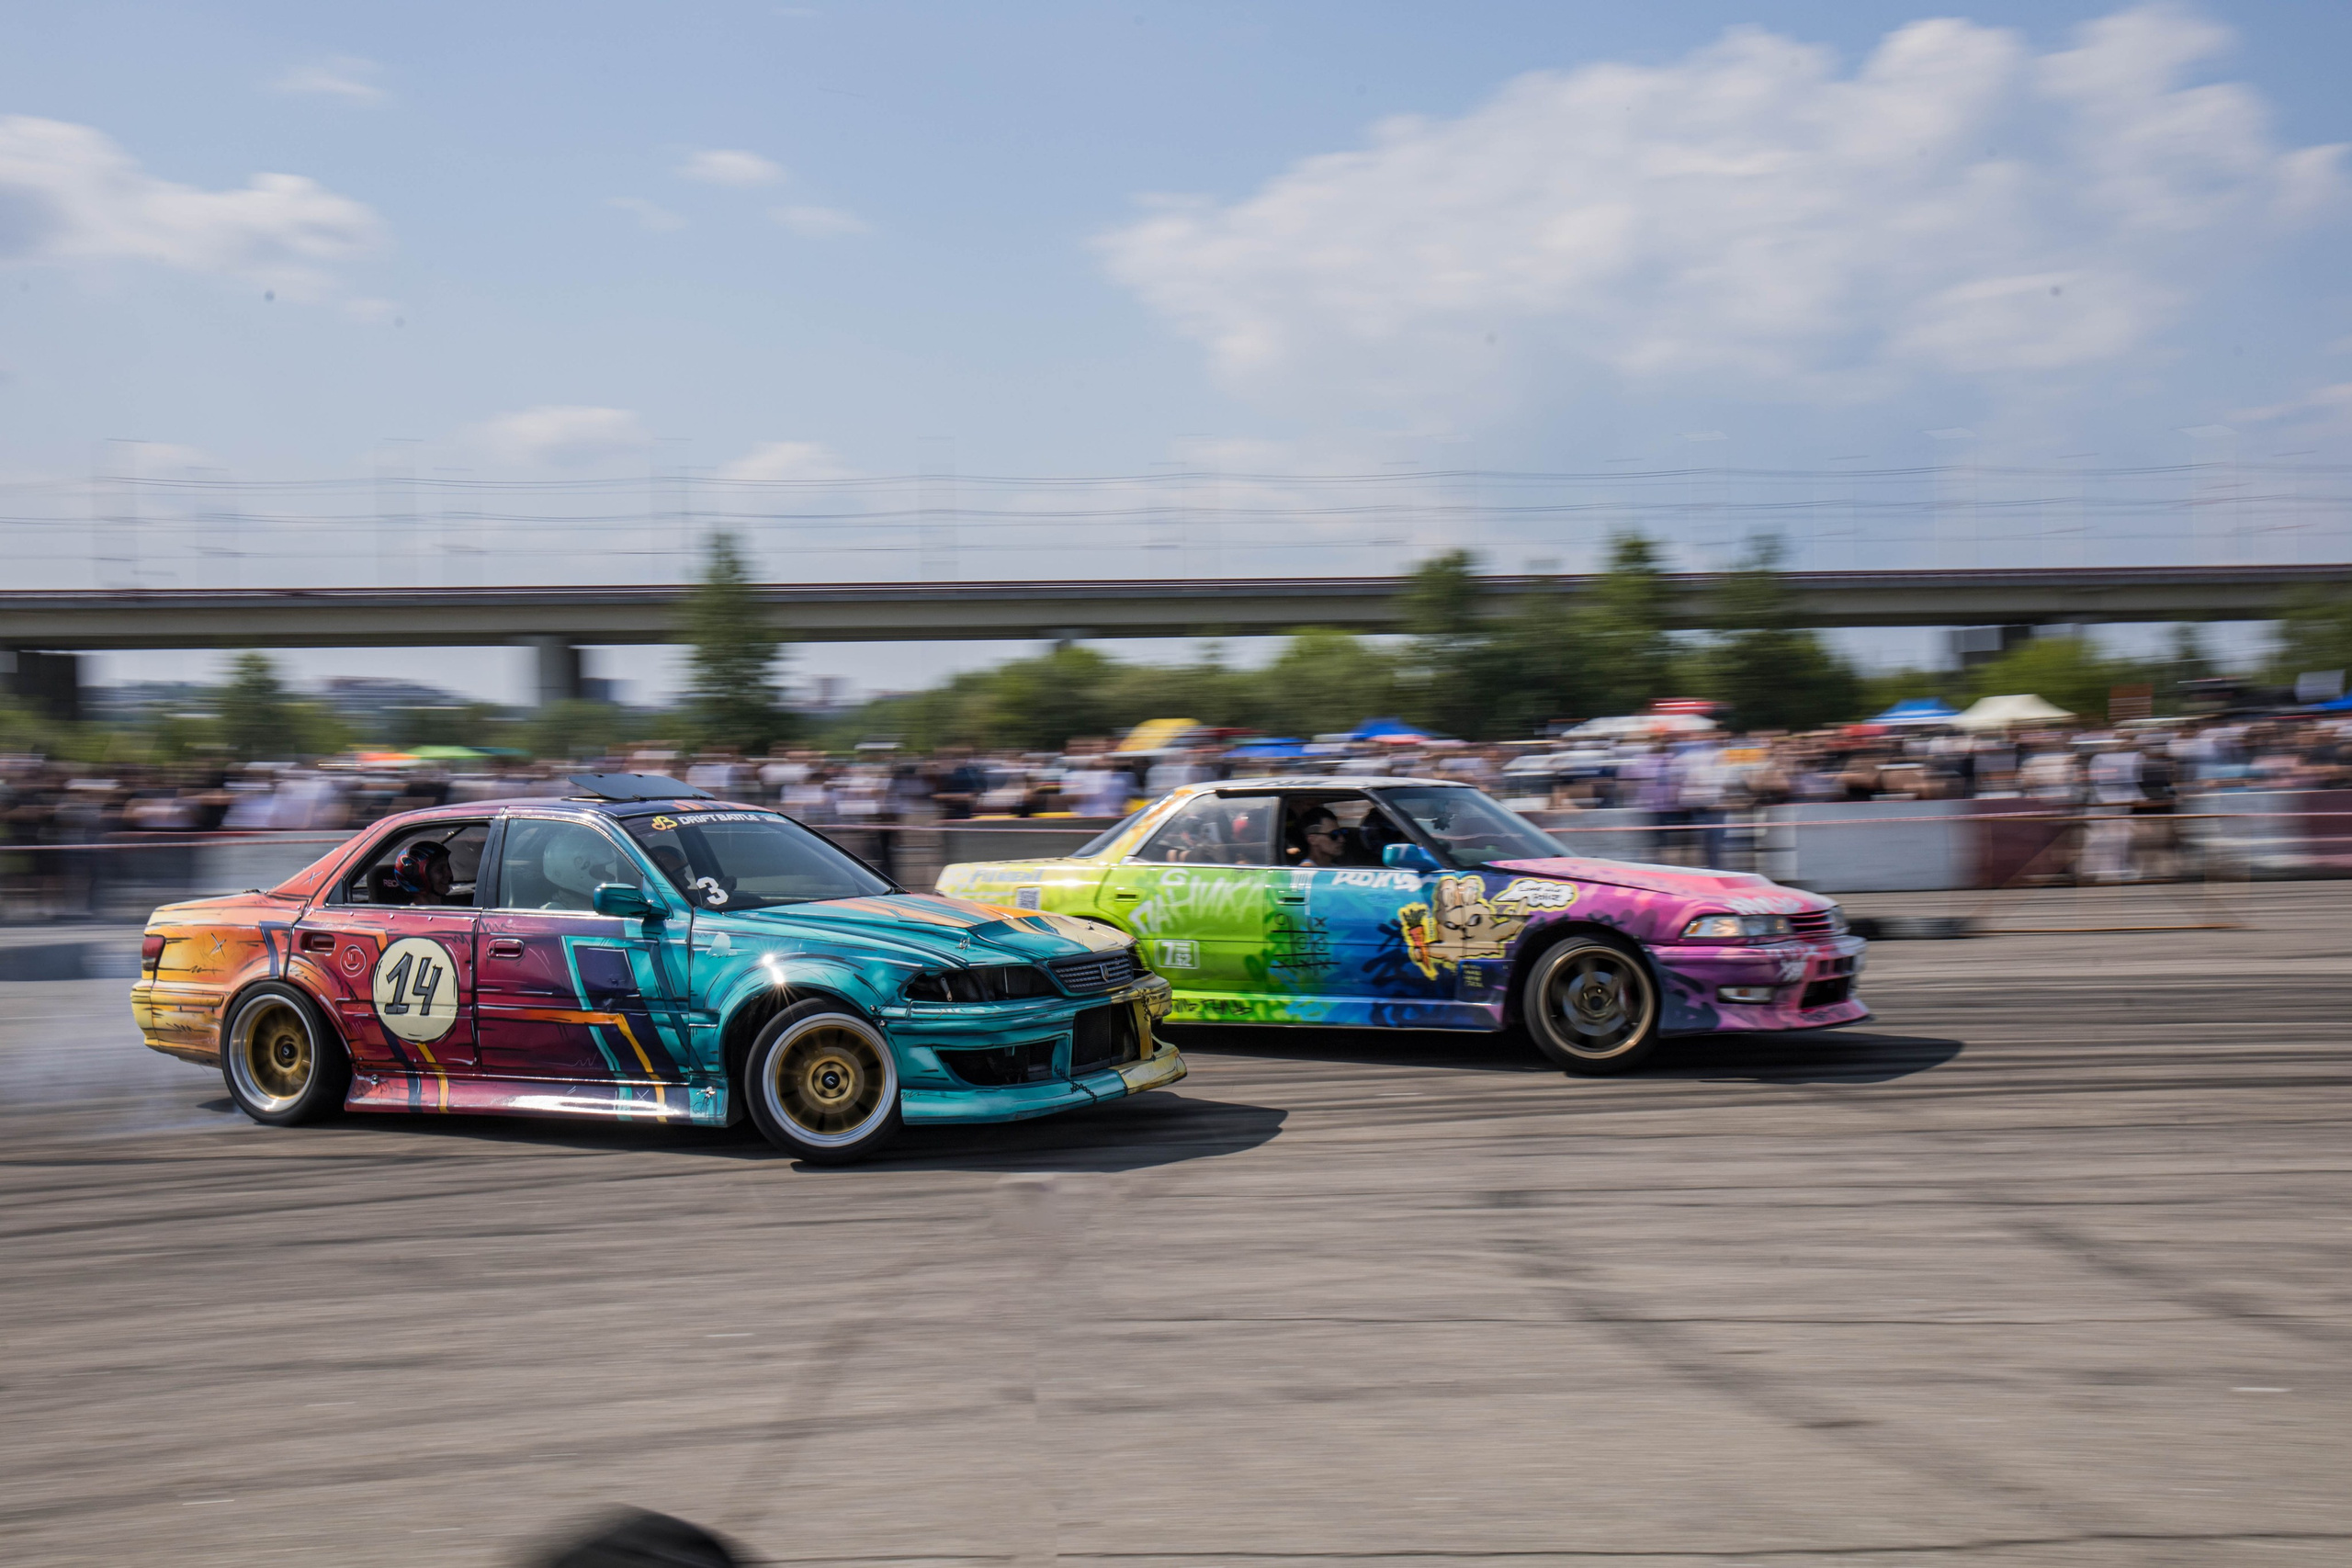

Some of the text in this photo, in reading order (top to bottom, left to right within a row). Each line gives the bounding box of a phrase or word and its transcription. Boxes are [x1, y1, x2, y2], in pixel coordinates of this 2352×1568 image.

[677, 814, 717, 825] DRIFT
[696, 876, 729, 905] 3
[384, 952, 443, 1016] 14
